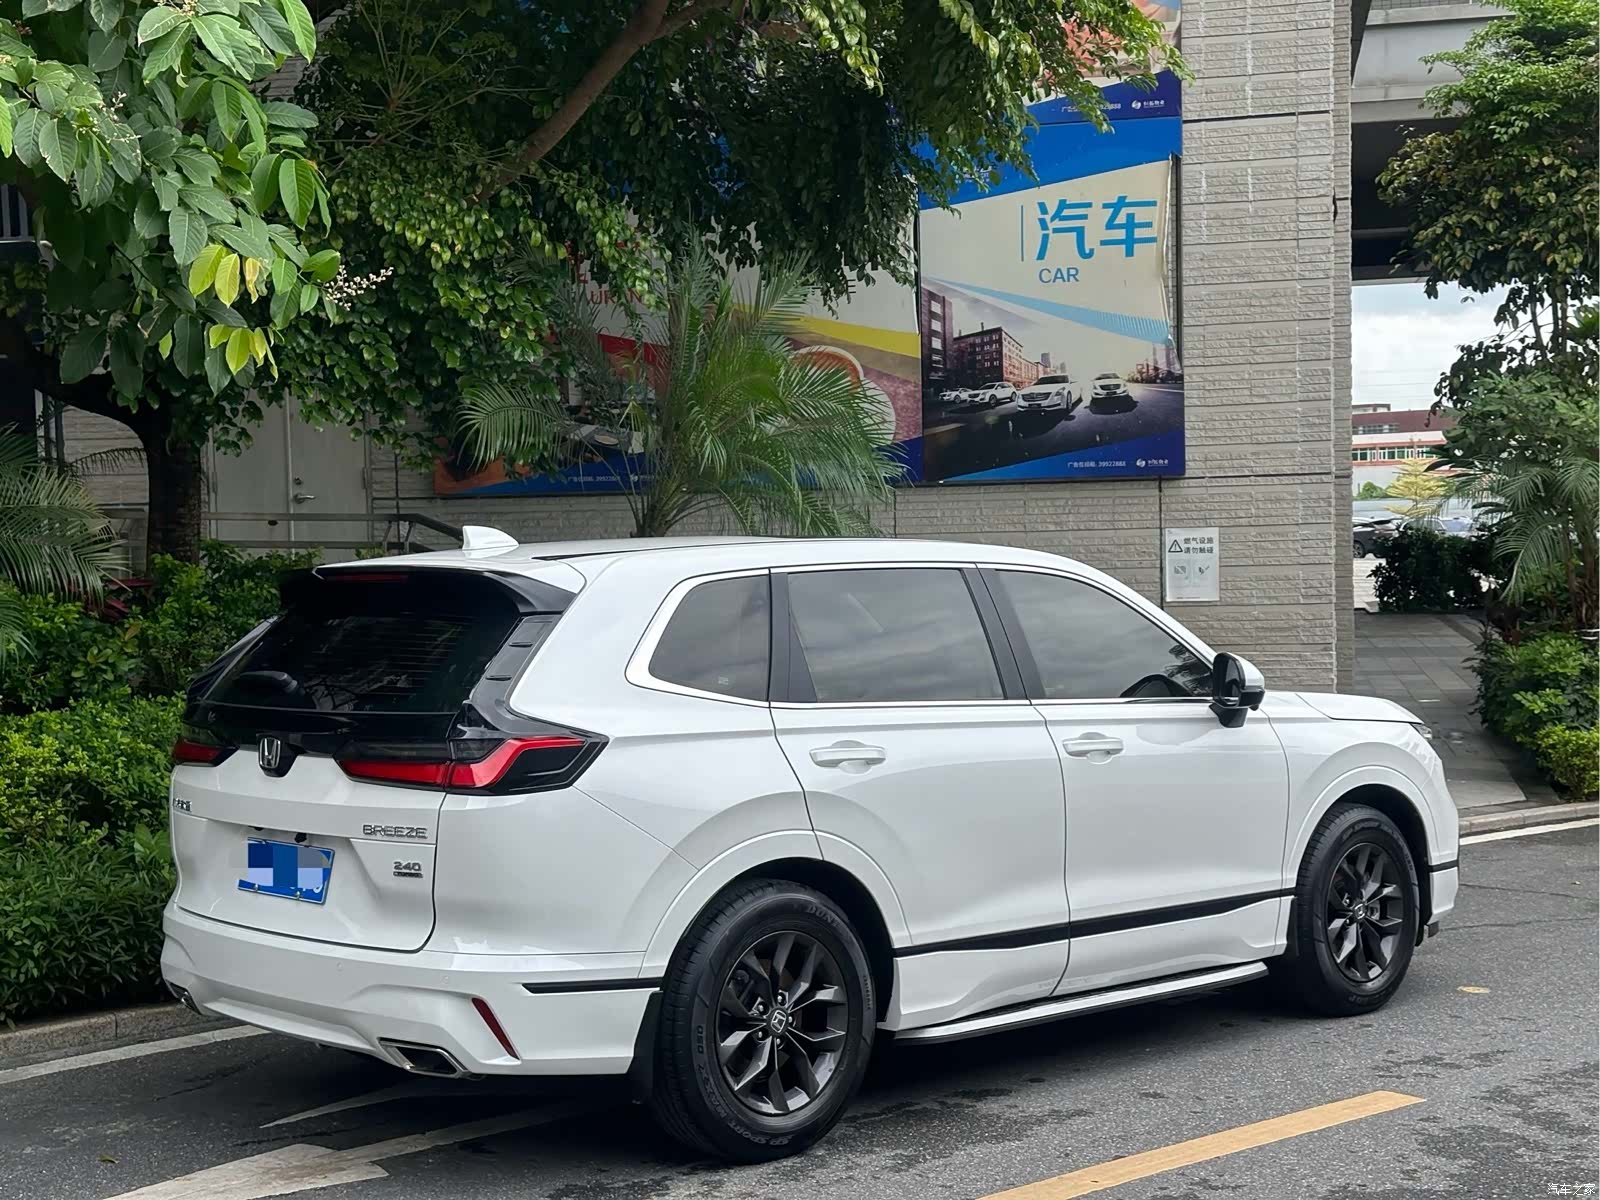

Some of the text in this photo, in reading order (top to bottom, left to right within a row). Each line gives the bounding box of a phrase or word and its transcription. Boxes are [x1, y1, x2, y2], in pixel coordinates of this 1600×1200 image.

[1036, 195, 1158, 261] 汽车
[1039, 267, 1080, 283] CAR
[362, 824, 428, 839] BREEZE
[393, 861, 422, 872] 240
